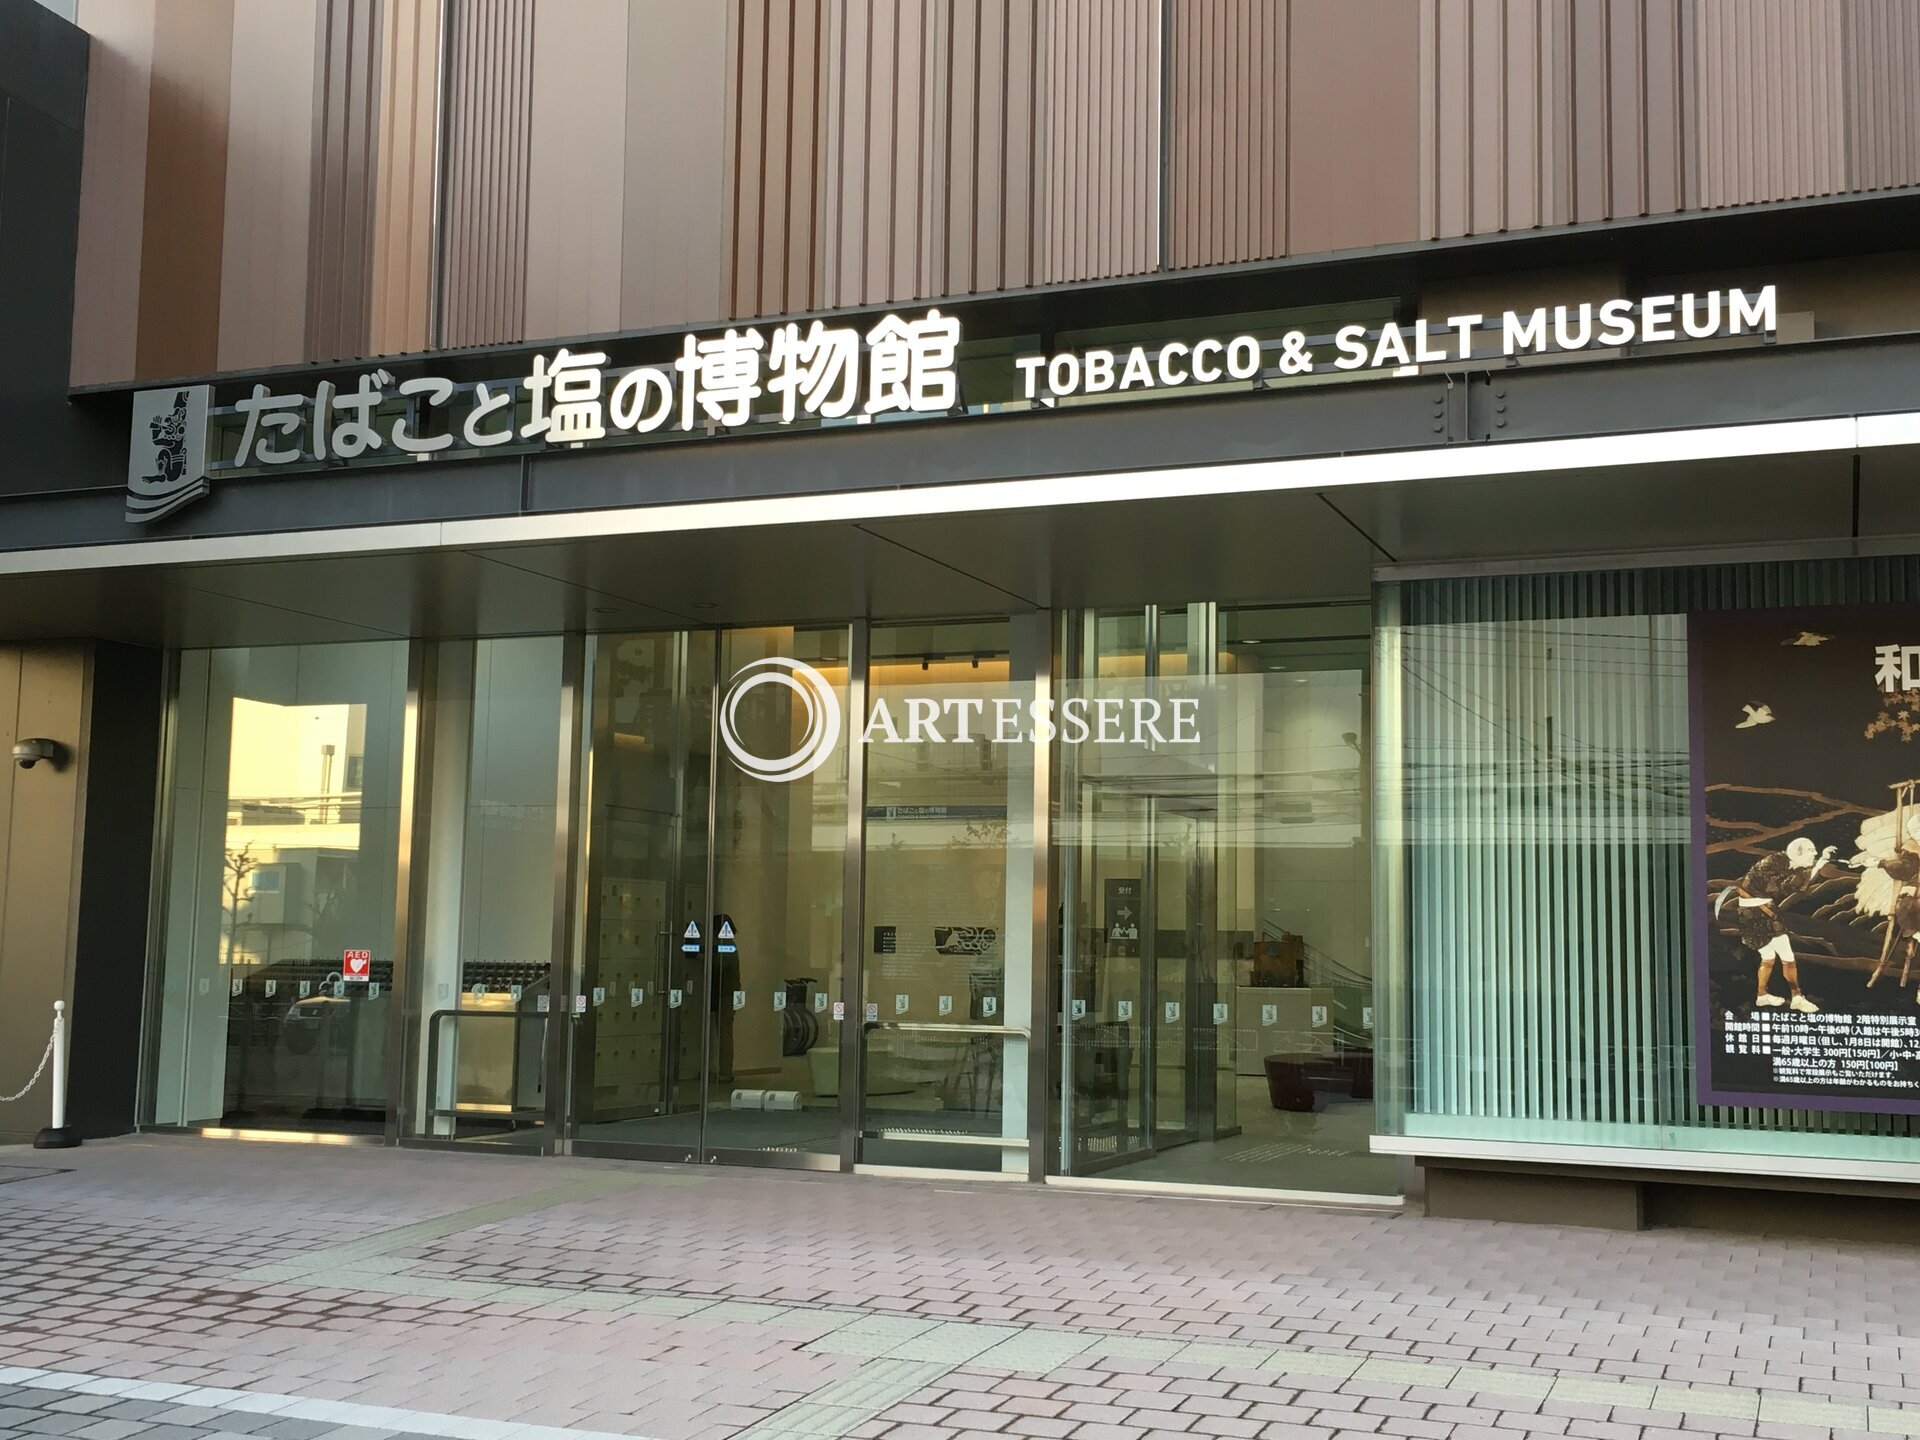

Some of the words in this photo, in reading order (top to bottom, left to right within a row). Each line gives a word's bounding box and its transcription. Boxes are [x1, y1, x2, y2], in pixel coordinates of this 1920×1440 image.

[233, 309, 962, 467] たばこと塩の博物館
[1015, 334, 1261, 401] TOBACCO
[1278, 330, 1313, 375] &
[1334, 314, 1482, 371] SALT
[1502, 285, 1778, 357] MUSEUM
[347, 951, 369, 959] AED
